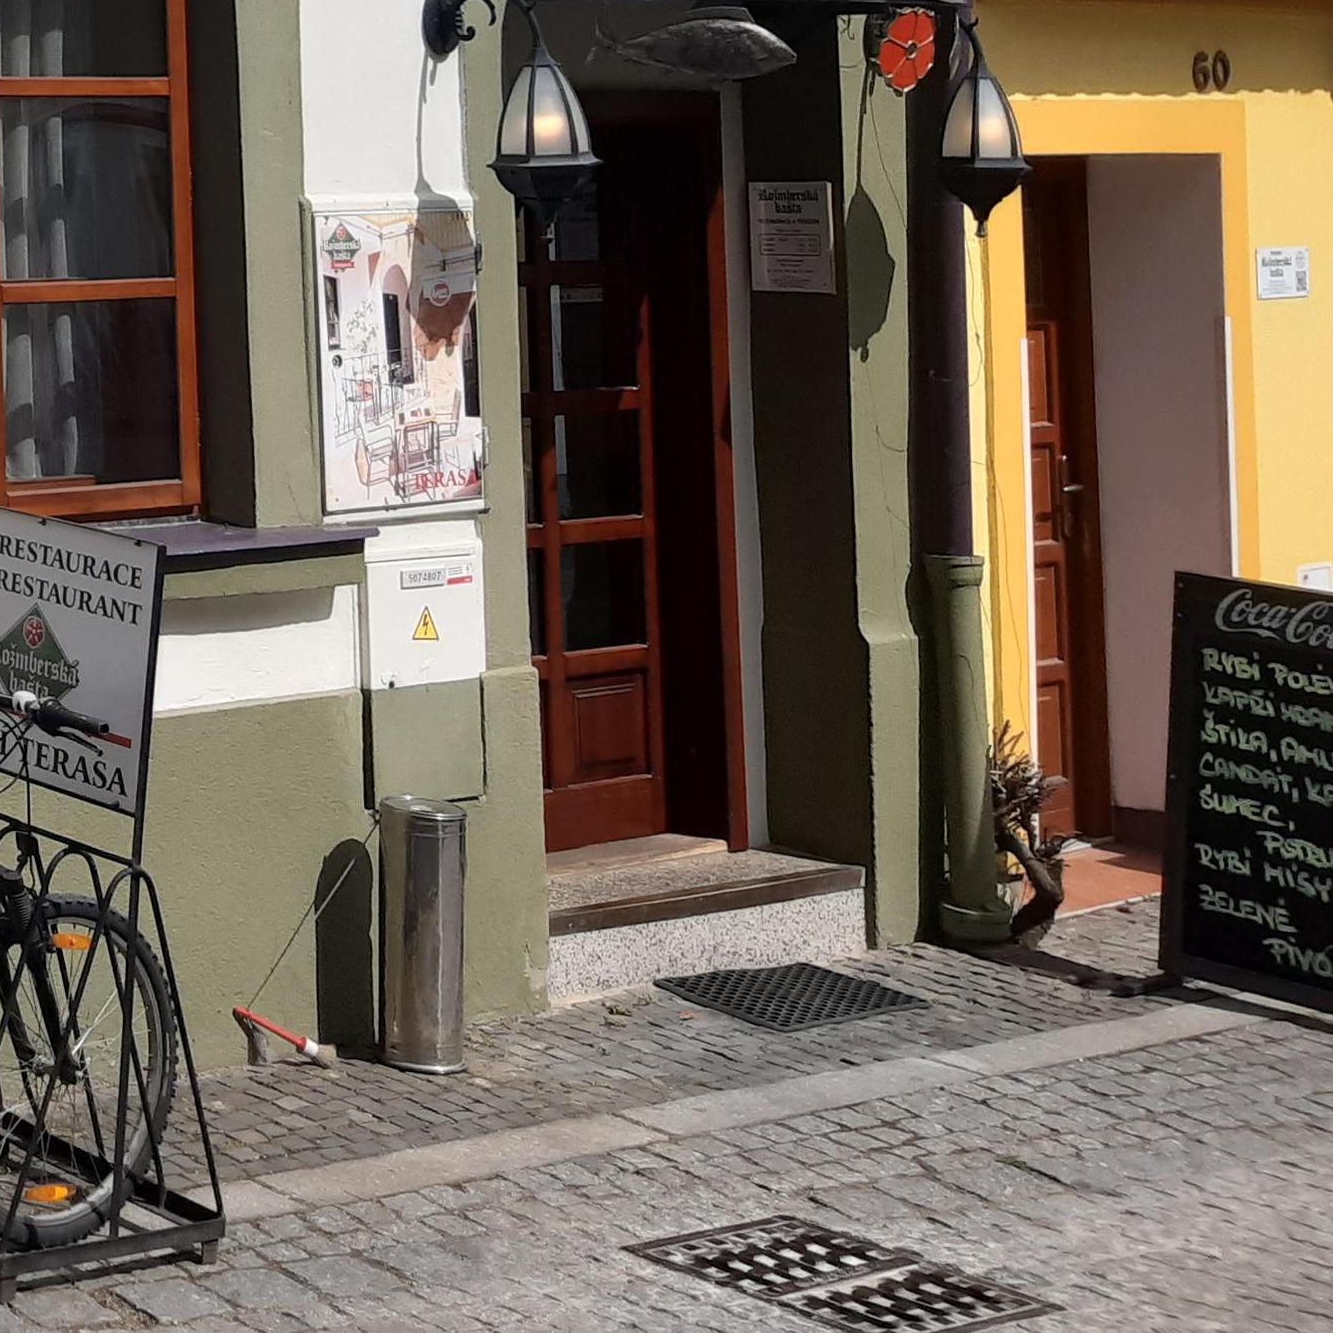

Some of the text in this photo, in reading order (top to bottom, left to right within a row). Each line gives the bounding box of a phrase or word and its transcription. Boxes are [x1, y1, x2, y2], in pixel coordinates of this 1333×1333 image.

[1192, 50, 1231, 94] 60
[0, 533, 144, 590] RESTAURACE
[1215, 588, 1333, 650] Coca-Co
[19, 736, 129, 798] TERASA
